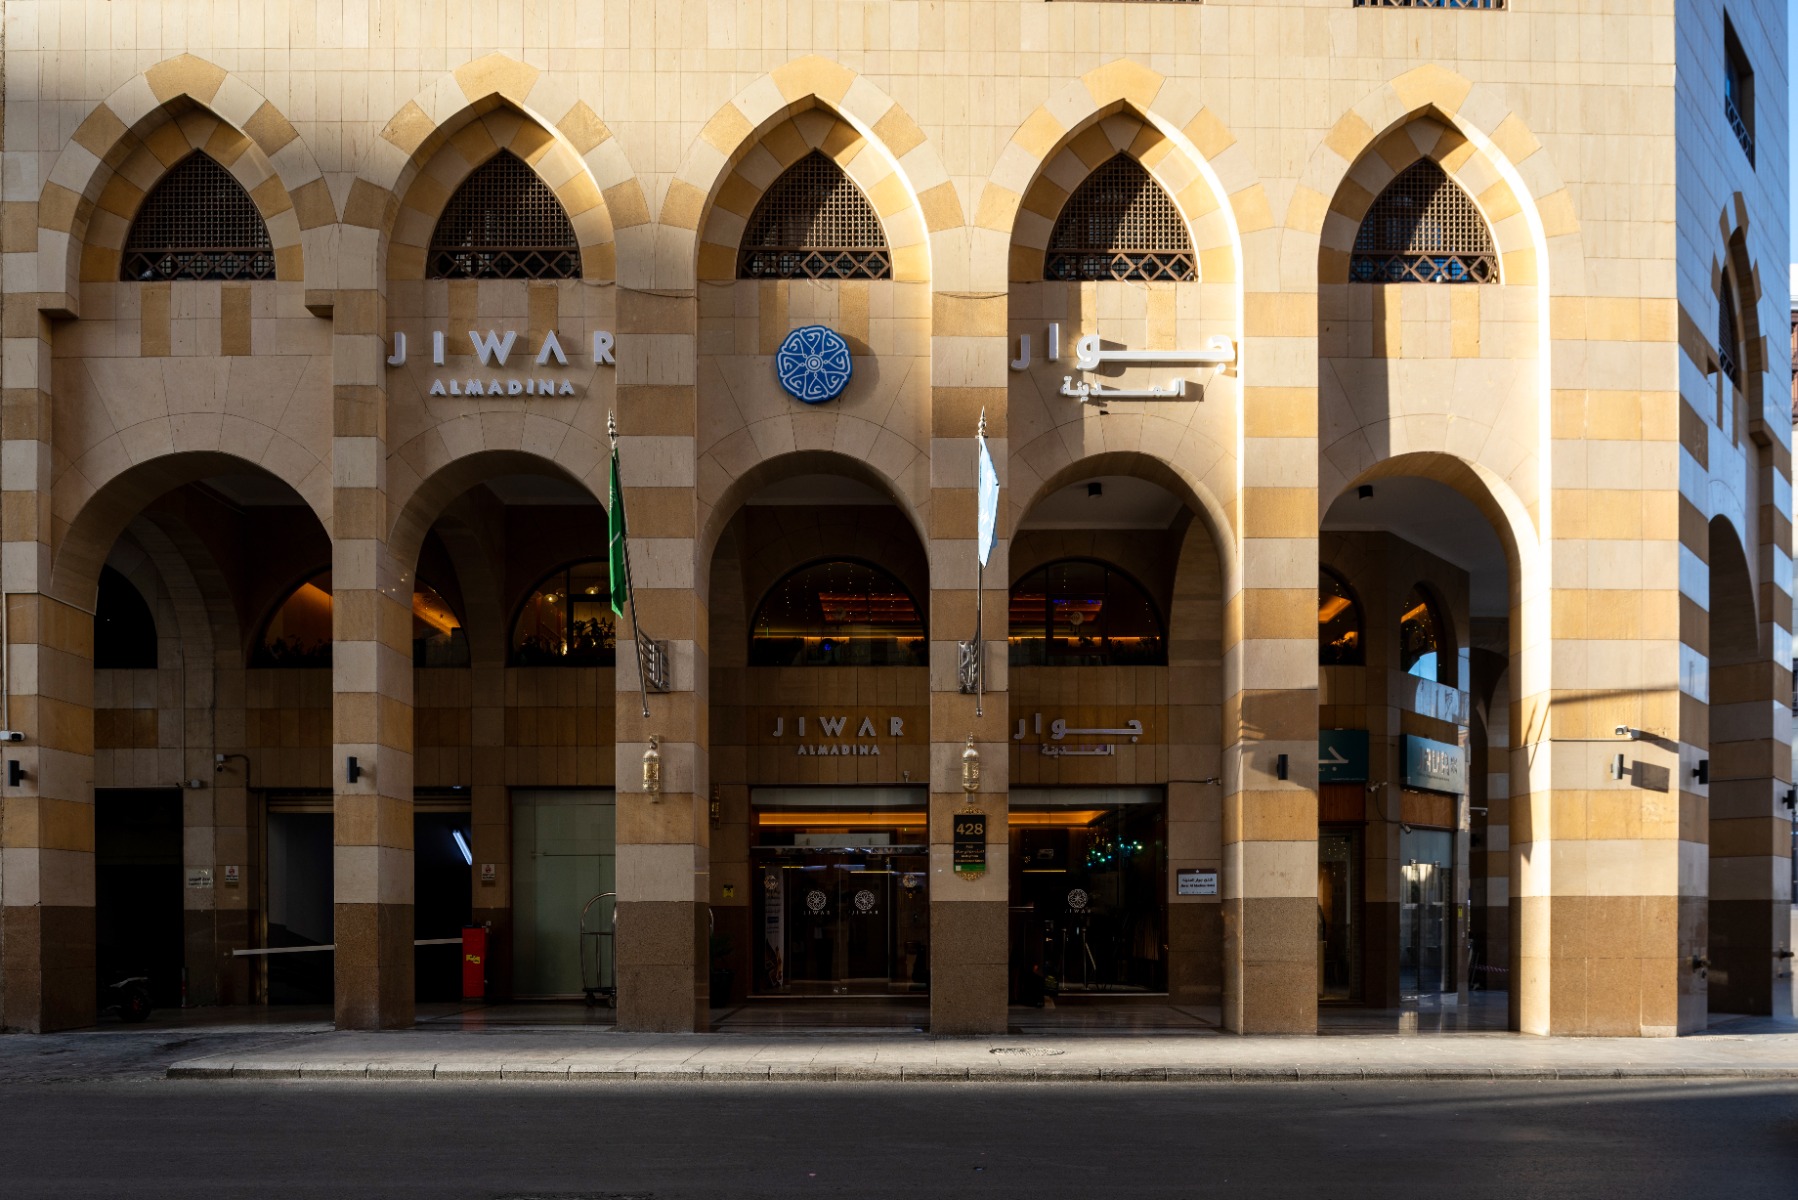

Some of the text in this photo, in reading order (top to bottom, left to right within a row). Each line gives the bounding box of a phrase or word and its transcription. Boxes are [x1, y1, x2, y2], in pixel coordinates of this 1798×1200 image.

[386, 329, 616, 367] JIWAR
[1011, 322, 1237, 374] جوار
[430, 378, 576, 397] ALMADINA
[1059, 375, 1186, 402] المدينة
[772, 716, 905, 737] JIWAR
[1013, 712, 1144, 743] جوار
[797, 744, 881, 756] ALMADINA
[1041, 743, 1115, 759] المدينة
[956, 823, 984, 836] 428
